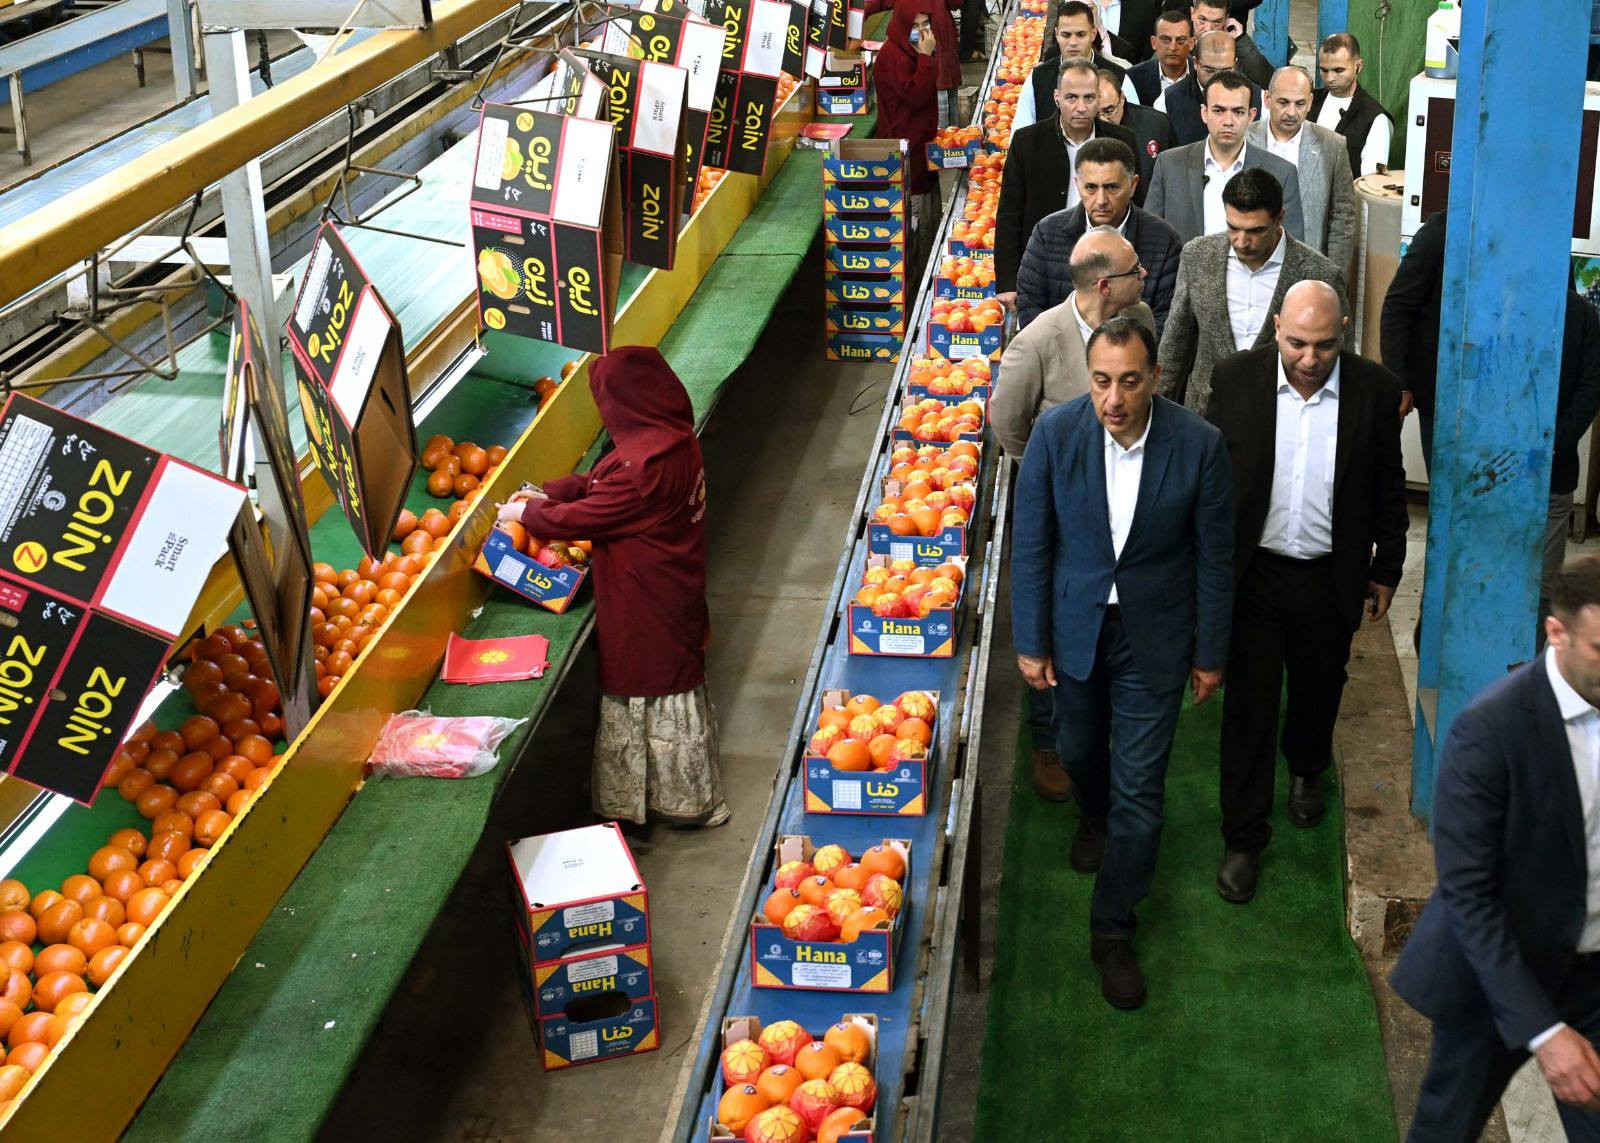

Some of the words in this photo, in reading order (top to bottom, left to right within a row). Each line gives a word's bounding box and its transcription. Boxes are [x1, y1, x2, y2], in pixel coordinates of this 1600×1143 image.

[831, 96, 851, 104] Hana
[943, 149, 966, 158] Hana
[524, 136, 552, 191] زين
[840, 163, 869, 178] هنا
[841, 194, 870, 209] هنا
[842, 224, 870, 239] هنا
[842, 254, 871, 269] هنا
[523, 257, 554, 307] زين
[567, 266, 599, 316] زين
[842, 284, 870, 300] هنا
[956, 288, 984, 299] Hana
[843, 315, 870, 329] هنا
[951, 334, 979, 345] Hana
[841, 345, 871, 358] Hana
[154, 539, 175, 568] Pack
[164, 535, 189, 572] Smart
[917, 543, 944, 558] هنا
[525, 567, 553, 590] هنا
[882, 620, 921, 636] Hana
[865, 780, 900, 798] هنا
[567, 921, 612, 938] Hana
[796, 945, 848, 963] Hana
[571, 975, 615, 994] Hana
[601, 1025, 633, 1041] هنا
